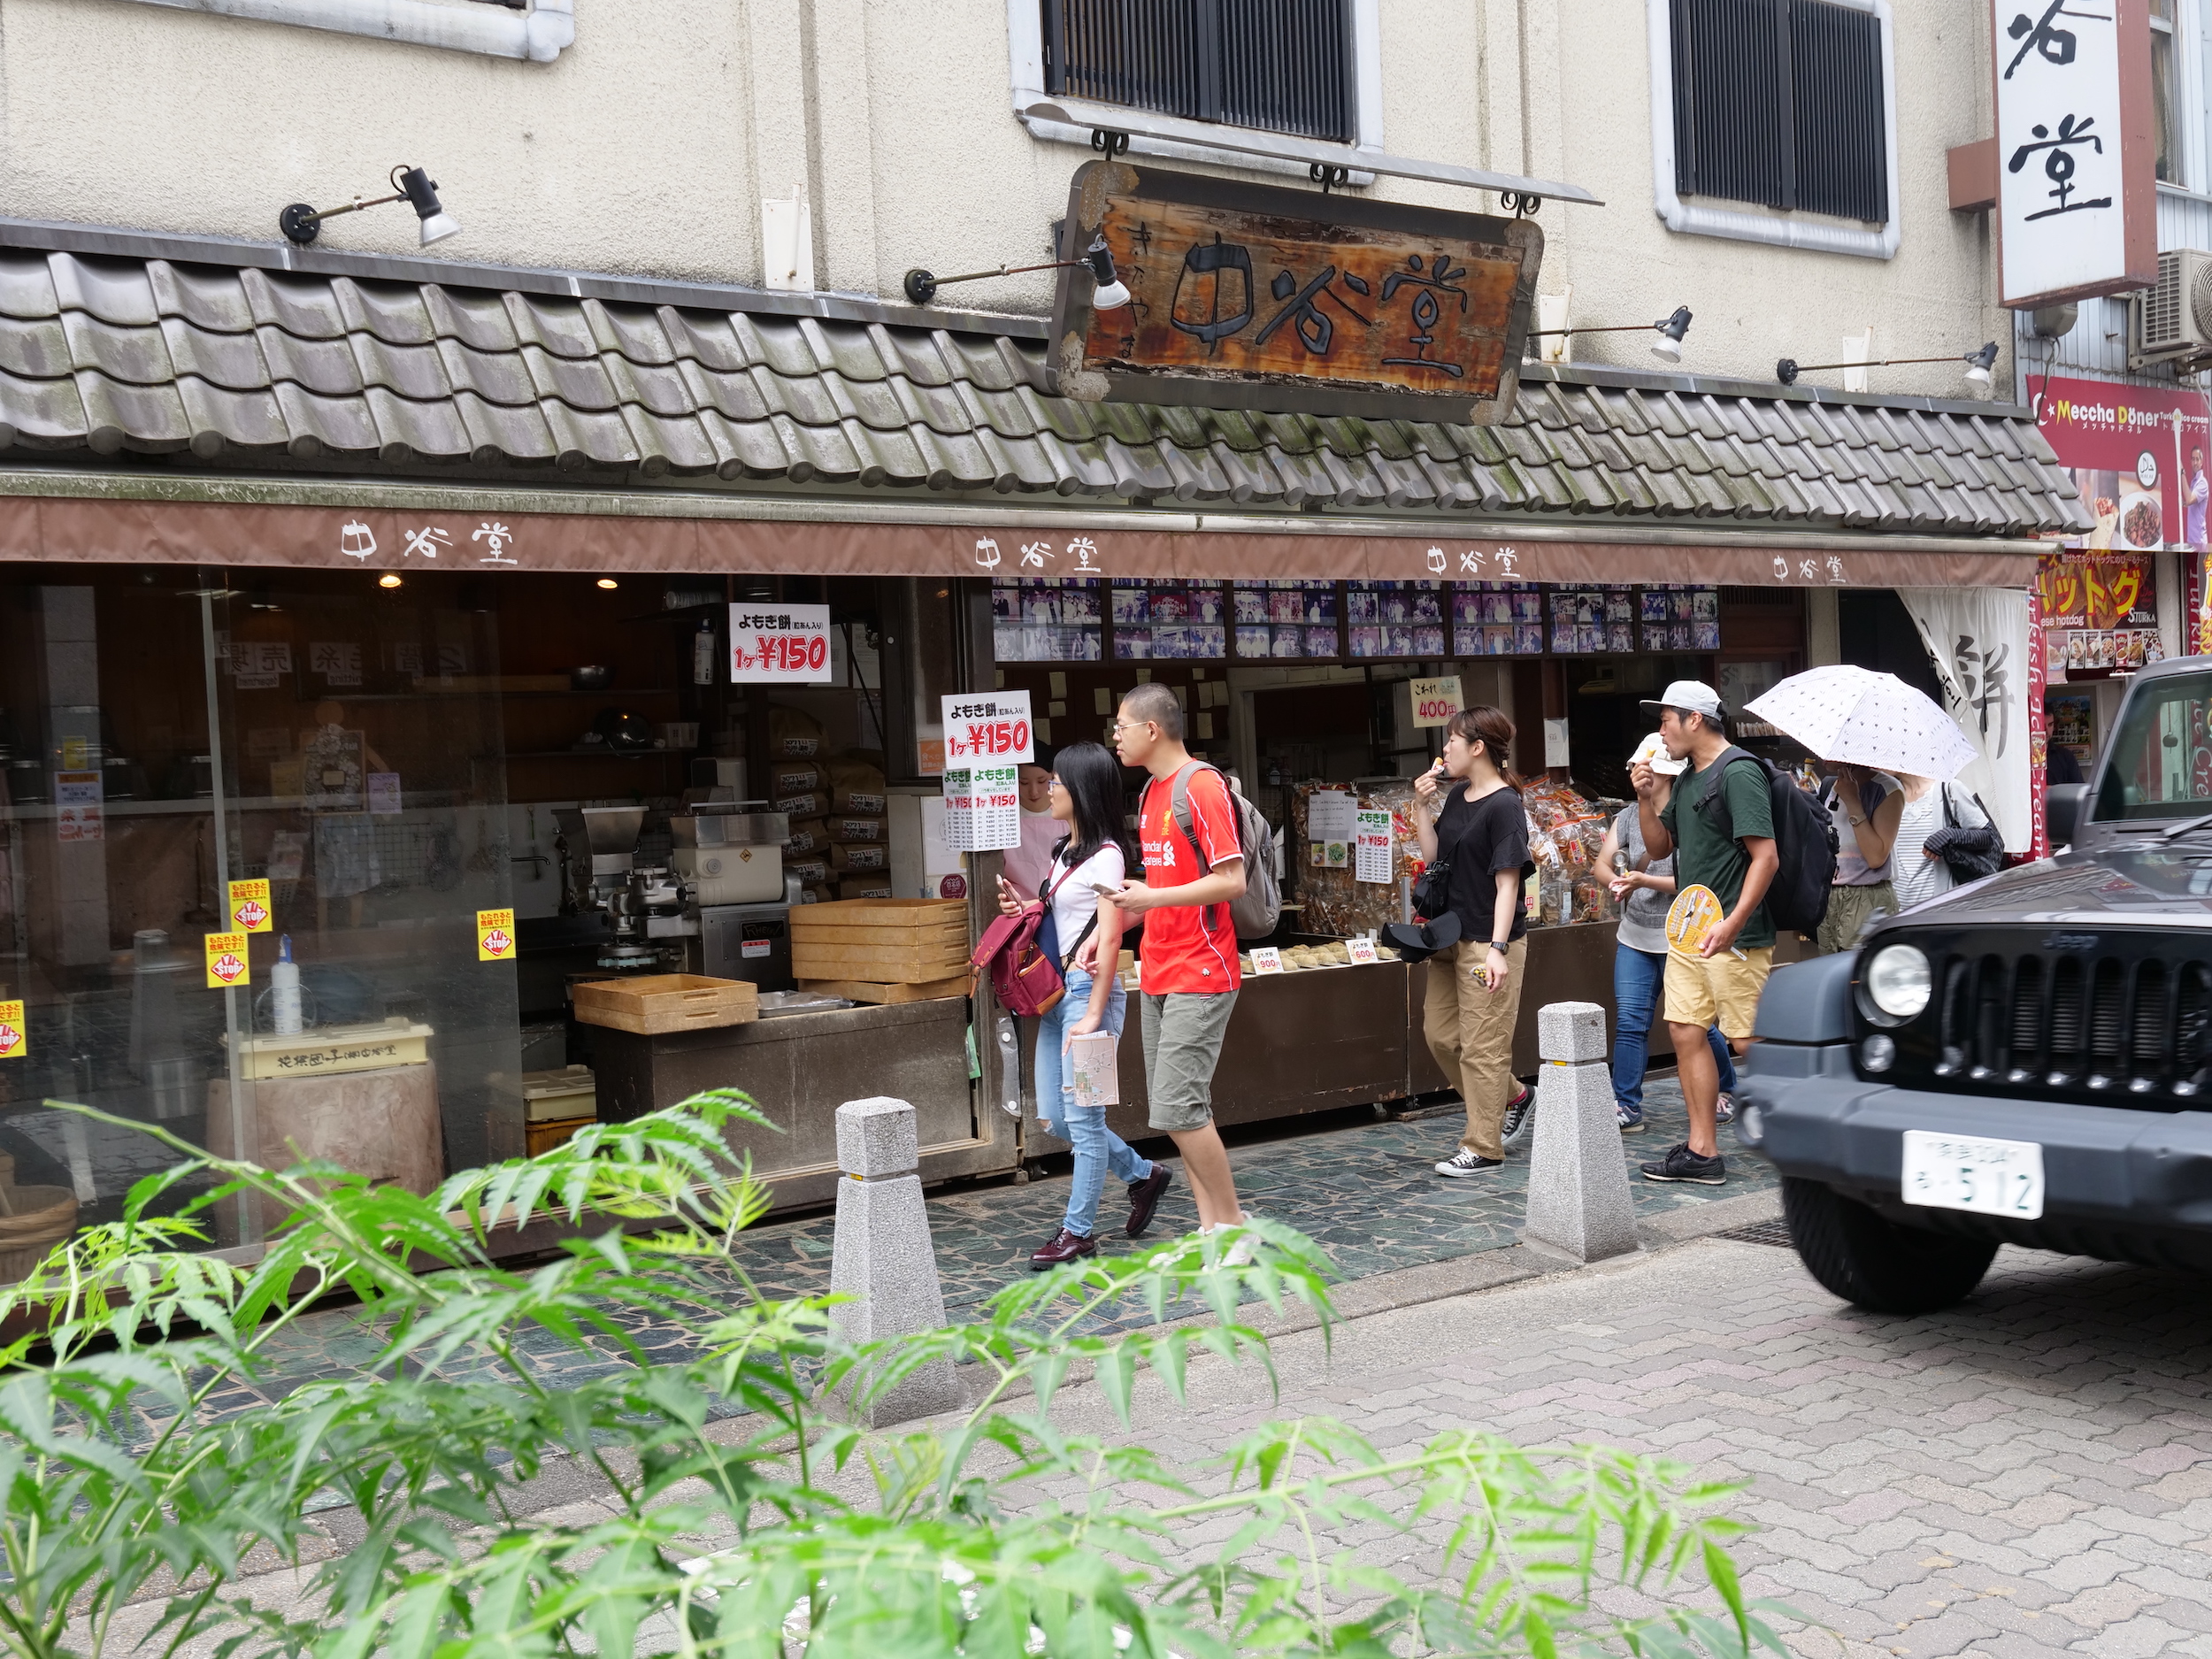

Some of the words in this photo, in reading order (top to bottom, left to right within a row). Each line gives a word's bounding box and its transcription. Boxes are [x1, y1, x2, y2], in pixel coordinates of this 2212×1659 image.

[1171, 232, 1468, 378] 中谷堂
[2056, 400, 2115, 426] Meccha
[2118, 406, 2159, 426] Döner
[342, 519, 518, 565] 中谷堂
[975, 535, 1101, 572] 中谷堂
[1427, 545, 1520, 578] 中谷堂
[1774, 555, 1846, 582] 中谷堂
[739, 615, 791, 630] よもぎ餅
[2056, 615, 2085, 626] hotdog
[1415, 683, 1438, 695] こわれ
[951, 702, 996, 718] よもぎ餅
[1418, 700, 1456, 718] 400円
[974, 768, 1016, 781] よもぎ餅
[989, 795, 1017, 807] ¥150
[1357, 812, 1389, 824] よもぎ餅
[232, 882, 266, 891] もたれると
[242, 911, 262, 921] STOP
[480, 911, 511, 920] もたれると
[210, 935, 244, 944] もたれると
[488, 940, 506, 949] STOP
[2041, 931, 2099, 952] Jeep
[219, 965, 239, 974] STOP
